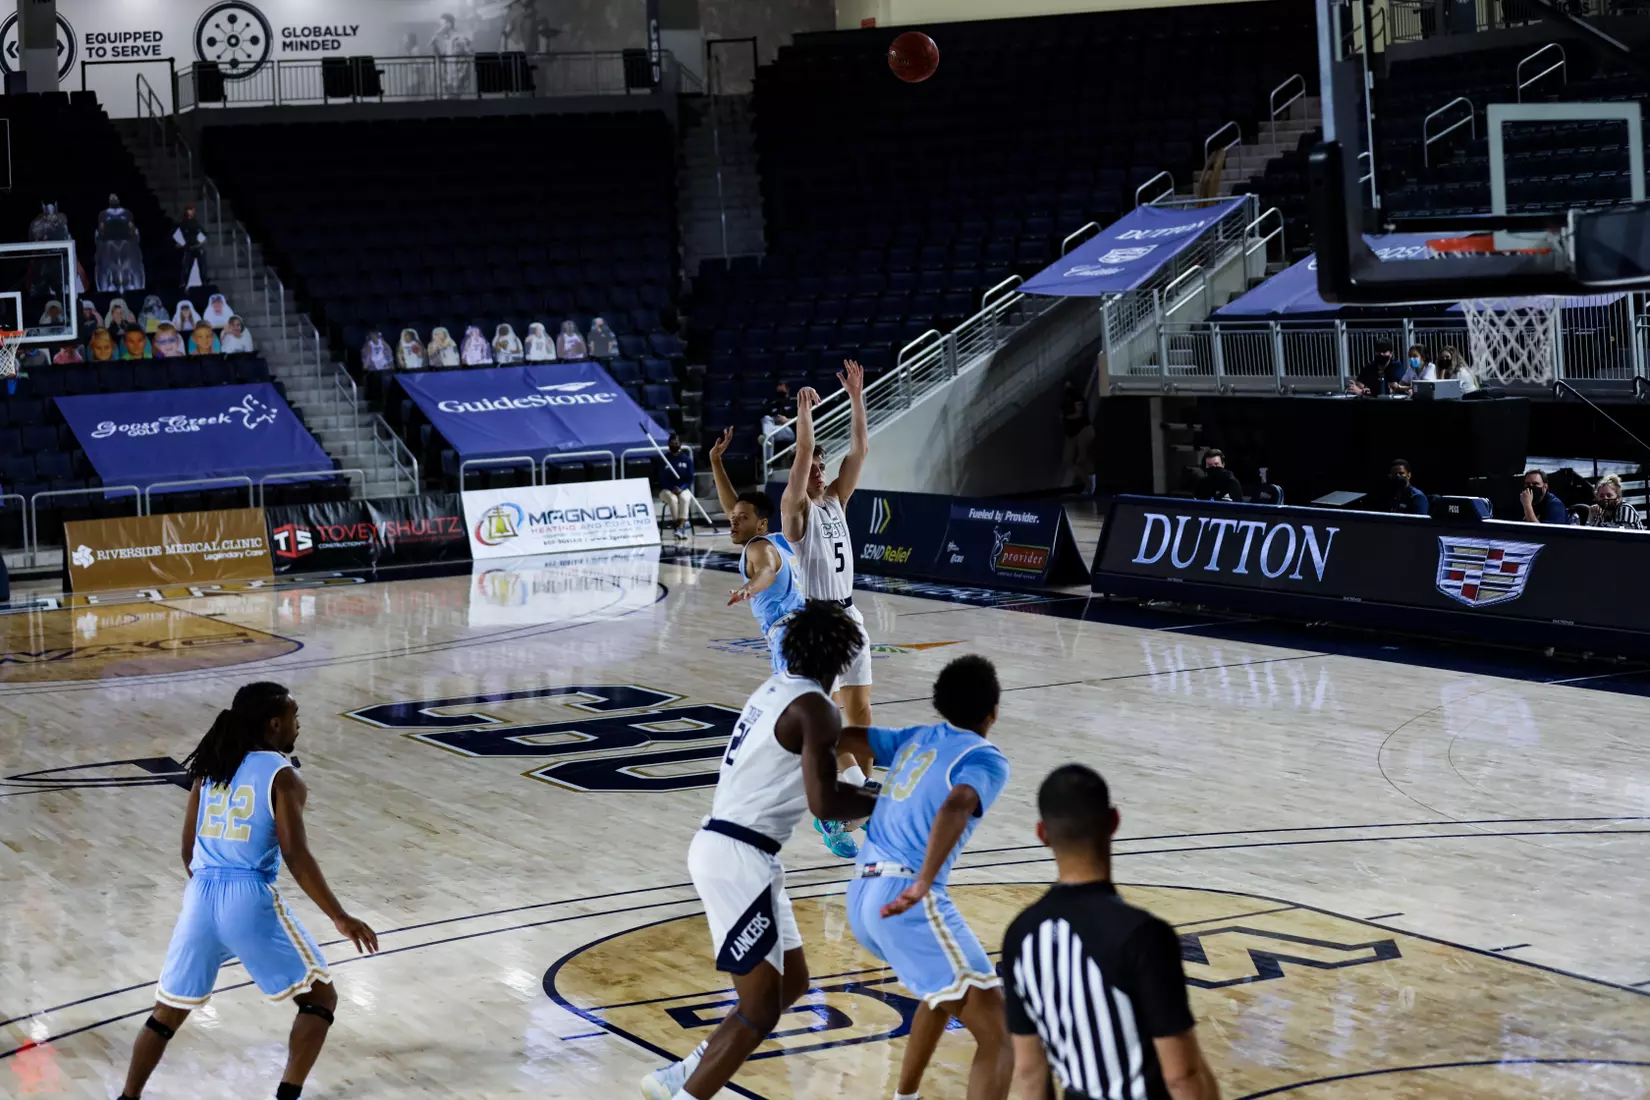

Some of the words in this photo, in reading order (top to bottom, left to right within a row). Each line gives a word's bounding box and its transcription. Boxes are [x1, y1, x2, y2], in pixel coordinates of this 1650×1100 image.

[86, 31, 163, 45] EQUIPPED
[282, 25, 360, 39] GLOBALLY
[86, 46, 107, 58] TO
[112, 44, 162, 57] SERVE
[282, 39, 342, 52] MINDED
[437, 391, 613, 413] GuideStone
[91, 420, 160, 438] Goose
[158, 412, 232, 427] Creek
[968, 507, 994, 520] Fueled
[995, 510, 1003, 523] by
[531, 524, 576, 535] HEATING
[97, 545, 162, 560] RIVERSIDE
[165, 540, 221, 554] MEDICAL
[221, 537, 263, 550] CLINIC
[834, 542, 845, 573] 5
[1001, 551, 1044, 565] provider
[1131, 511, 1340, 583] DUTTON
[880, 743, 937, 802] 13
[198, 782, 255, 842] 22
[729, 911, 771, 962] LANCERS
